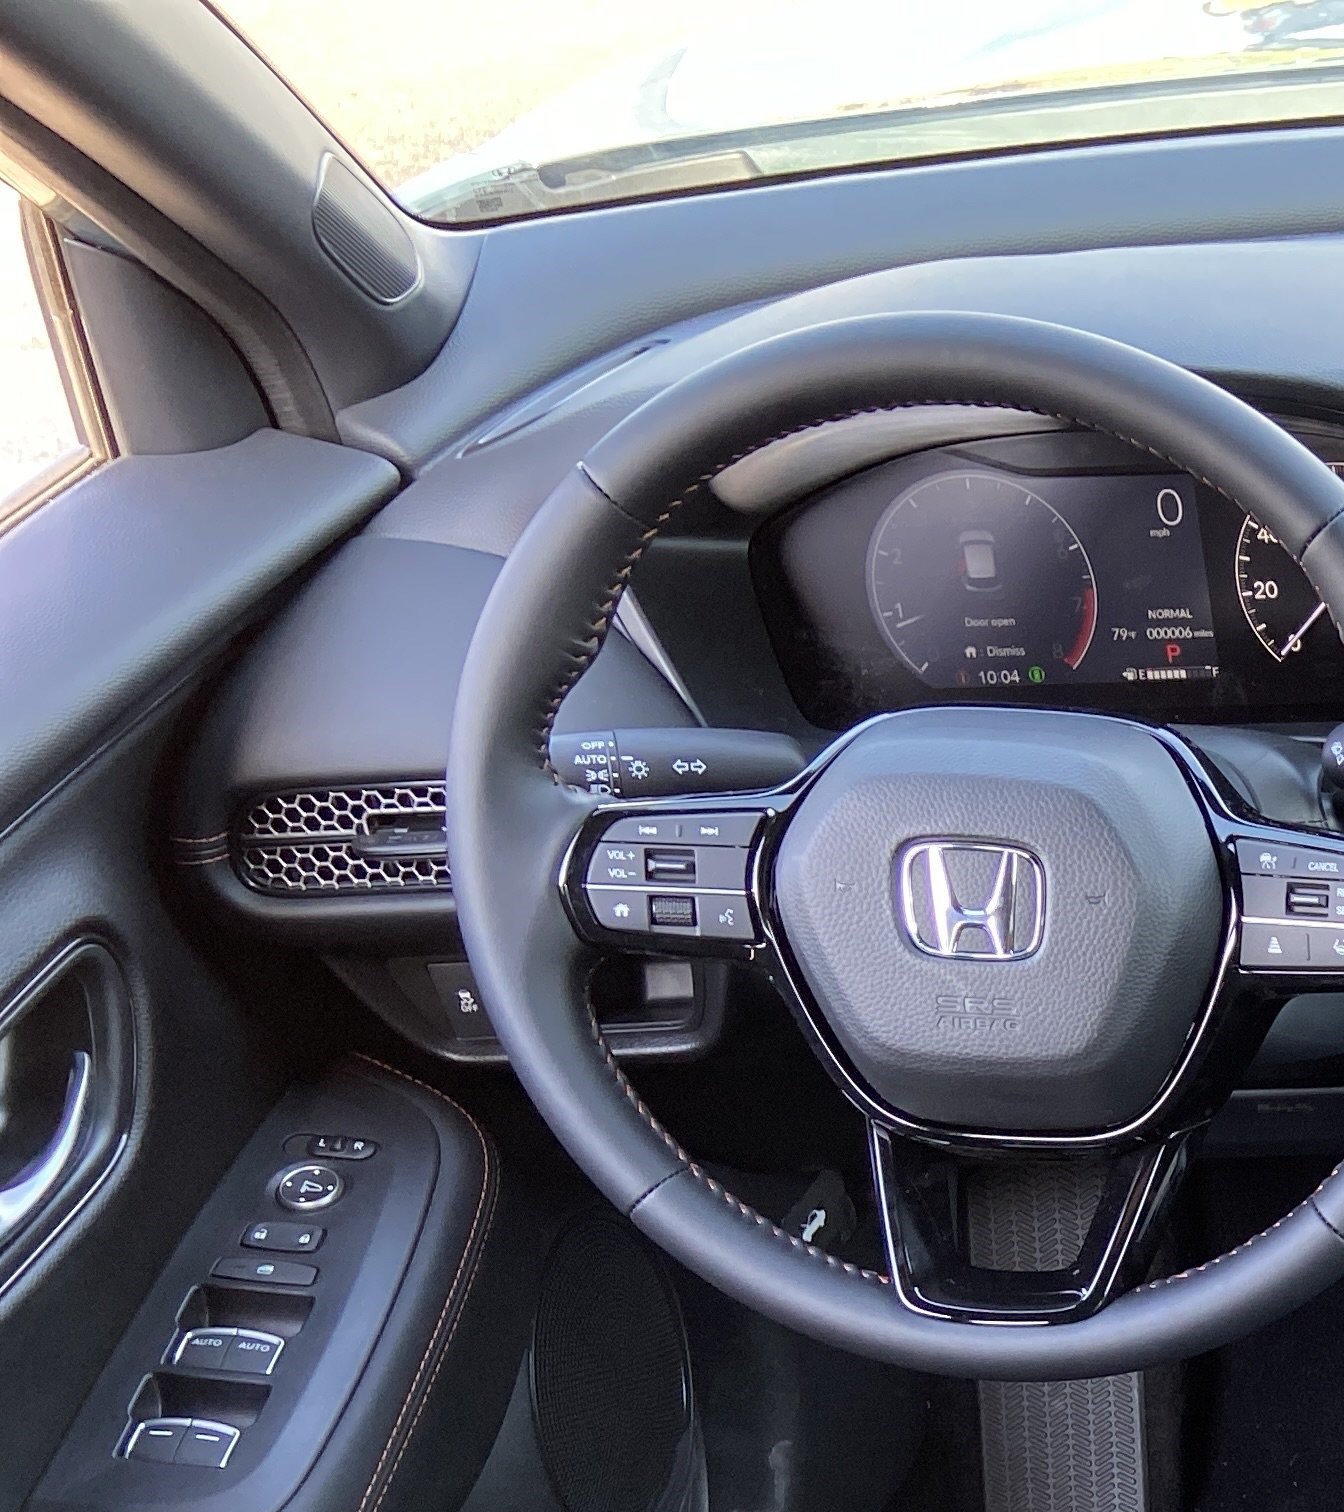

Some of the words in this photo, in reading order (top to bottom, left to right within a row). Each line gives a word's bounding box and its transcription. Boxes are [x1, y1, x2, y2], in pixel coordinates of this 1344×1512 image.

[1156, 488, 1183, 526] 0
[1149, 527, 1171, 538] mph
[1256, 528, 1280, 544] 4
[1253, 581, 1278, 599] 20
[1147, 608, 1193, 620] NORMAL
[964, 616, 989, 628] Door
[991, 616, 1016, 629] open
[1146, 626, 1193, 640] 000006
[987, 645, 1026, 658] Dismiss
[1166, 643, 1181, 663] P
[978, 669, 1021, 685] 10:04
[1139, 670, 1147, 680] E
[1212, 666, 1220, 678] F
[581, 740, 605, 750] OFF
[574, 754, 607, 765] AUTO
[1308, 861, 1339, 873] CANCEL
[936, 995, 1018, 1015] SRS
[936, 1015, 1020, 1031] AIRBAG
[318, 1138, 326, 1148] L
[353, 1140, 365, 1151] R
[191, 1337, 223, 1347] AUTO
[238, 1342, 270, 1353] AUTO
